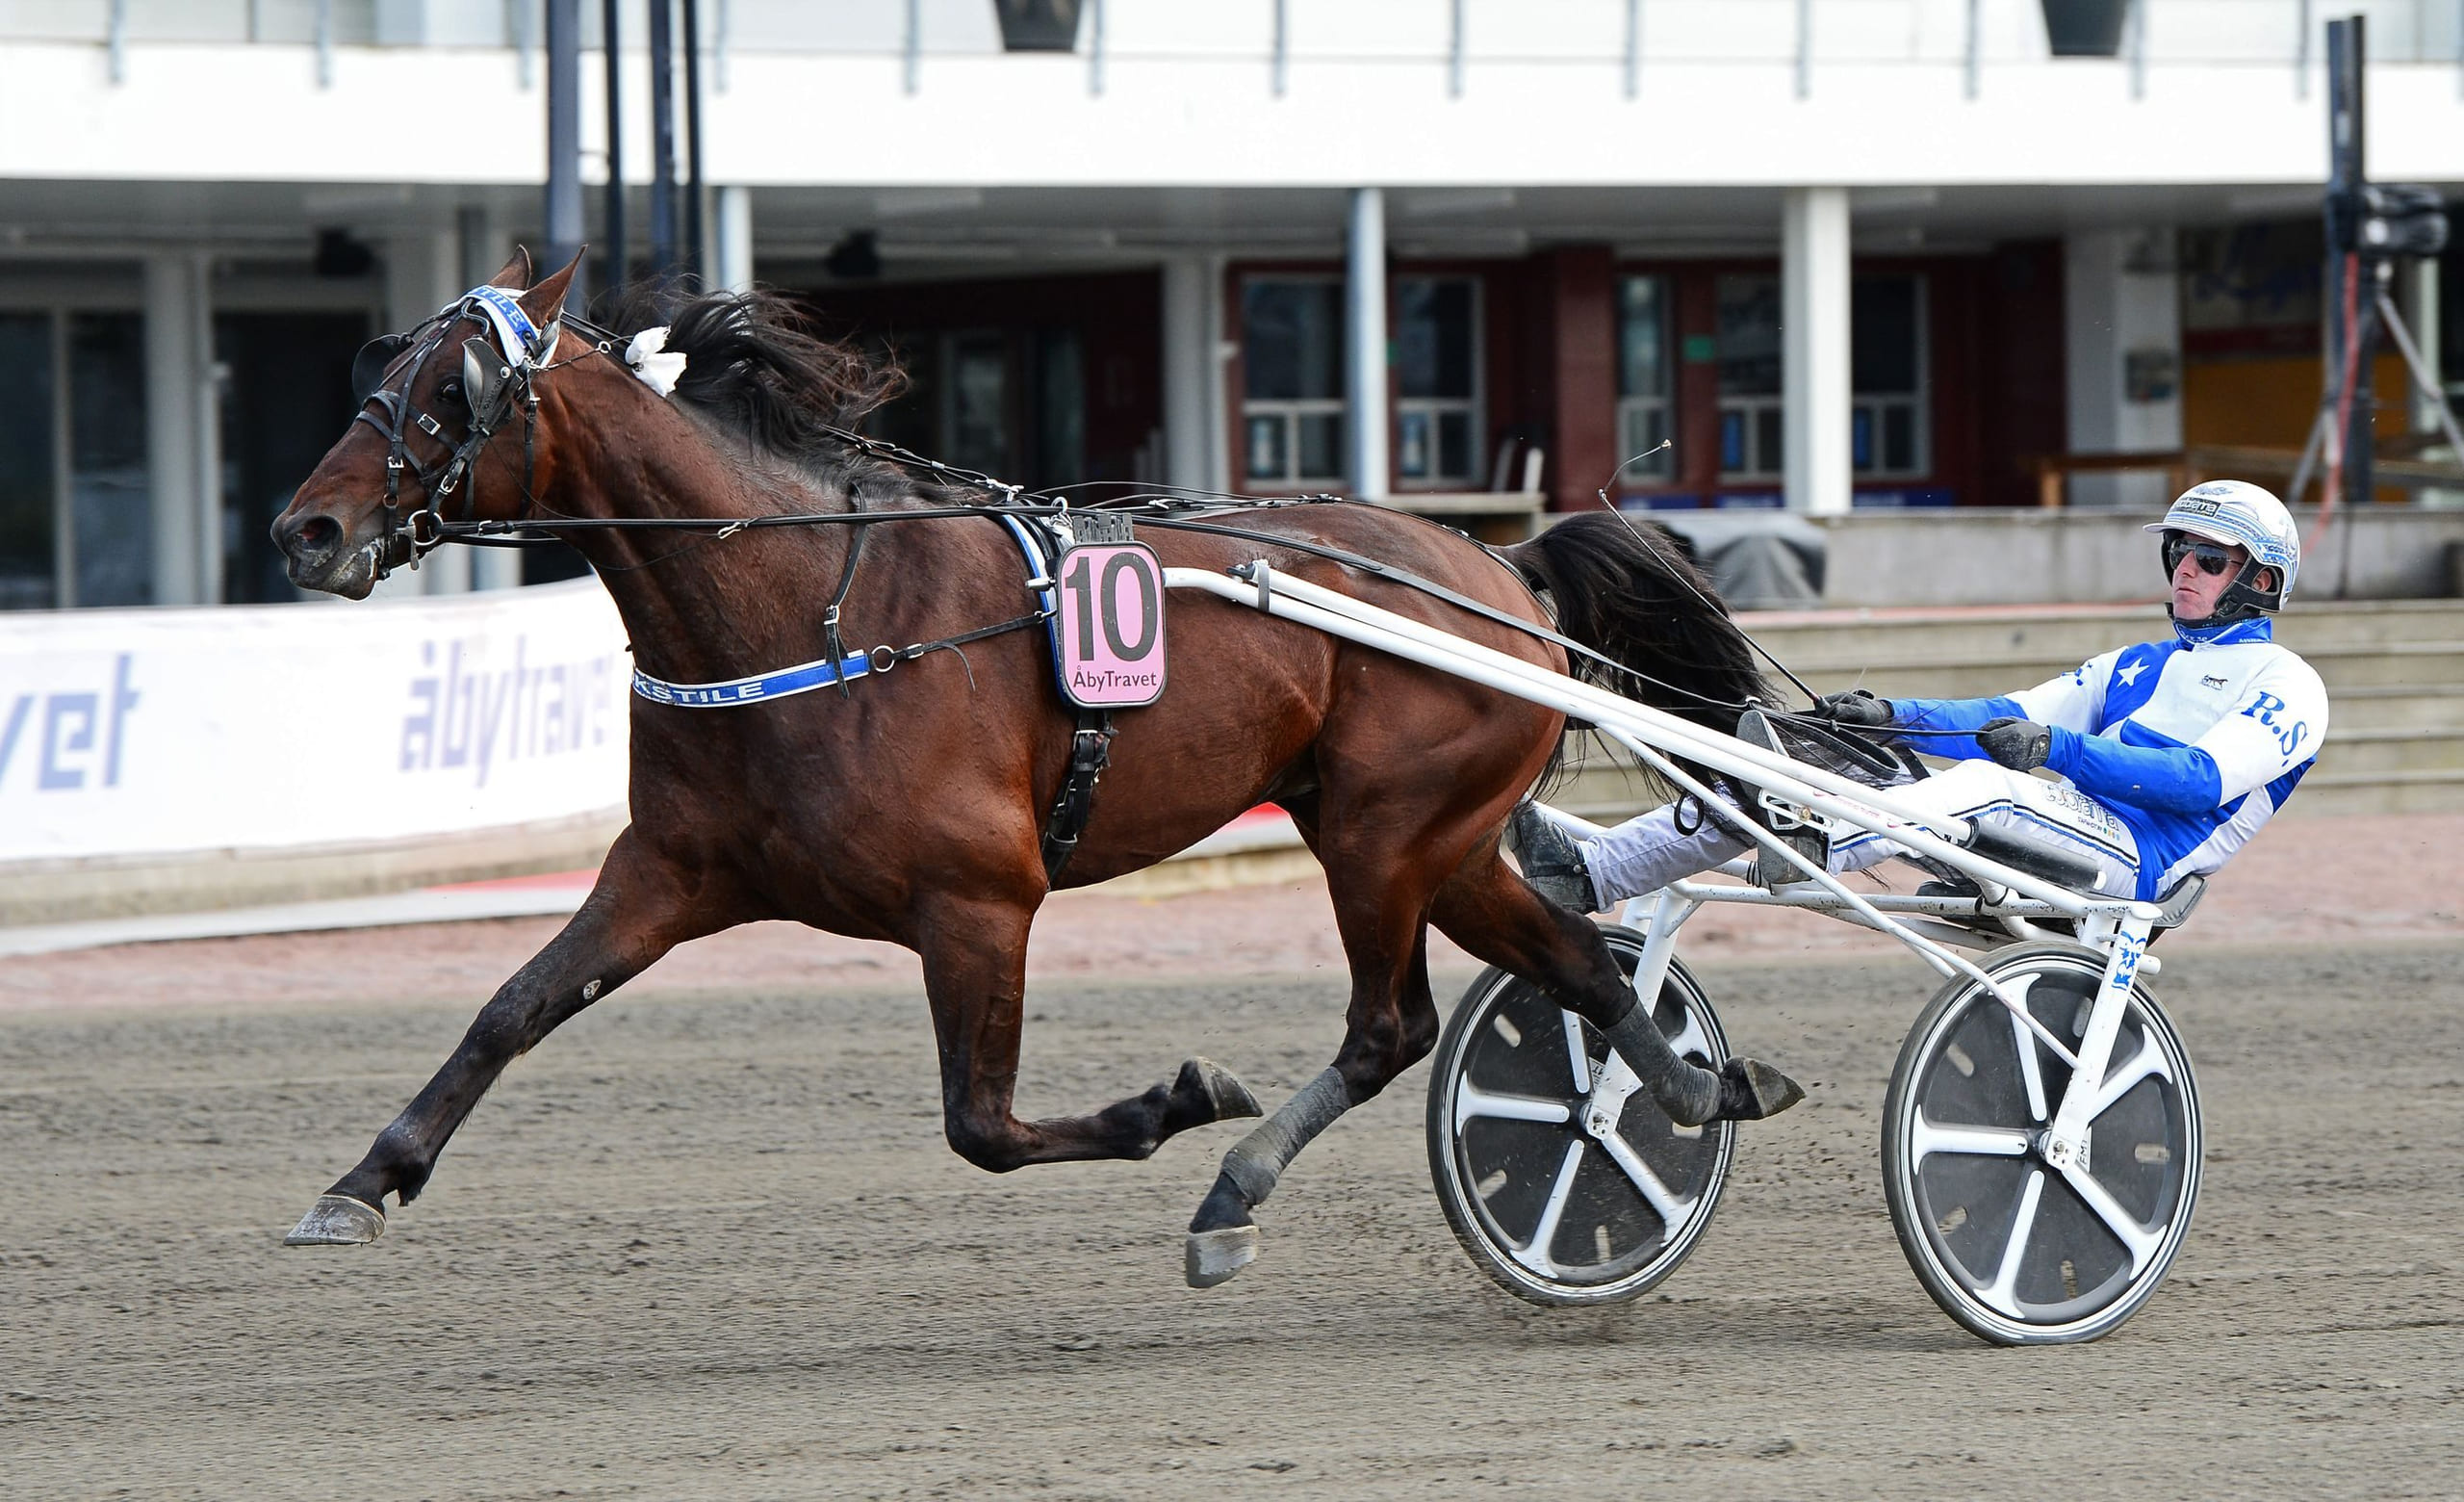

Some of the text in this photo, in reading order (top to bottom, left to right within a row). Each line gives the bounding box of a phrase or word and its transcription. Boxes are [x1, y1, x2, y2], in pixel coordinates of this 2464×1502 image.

[1065, 552, 1158, 662] 10
[398, 634, 614, 790] åbytrave
[1073, 664, 1157, 692] ÅbyTravet
